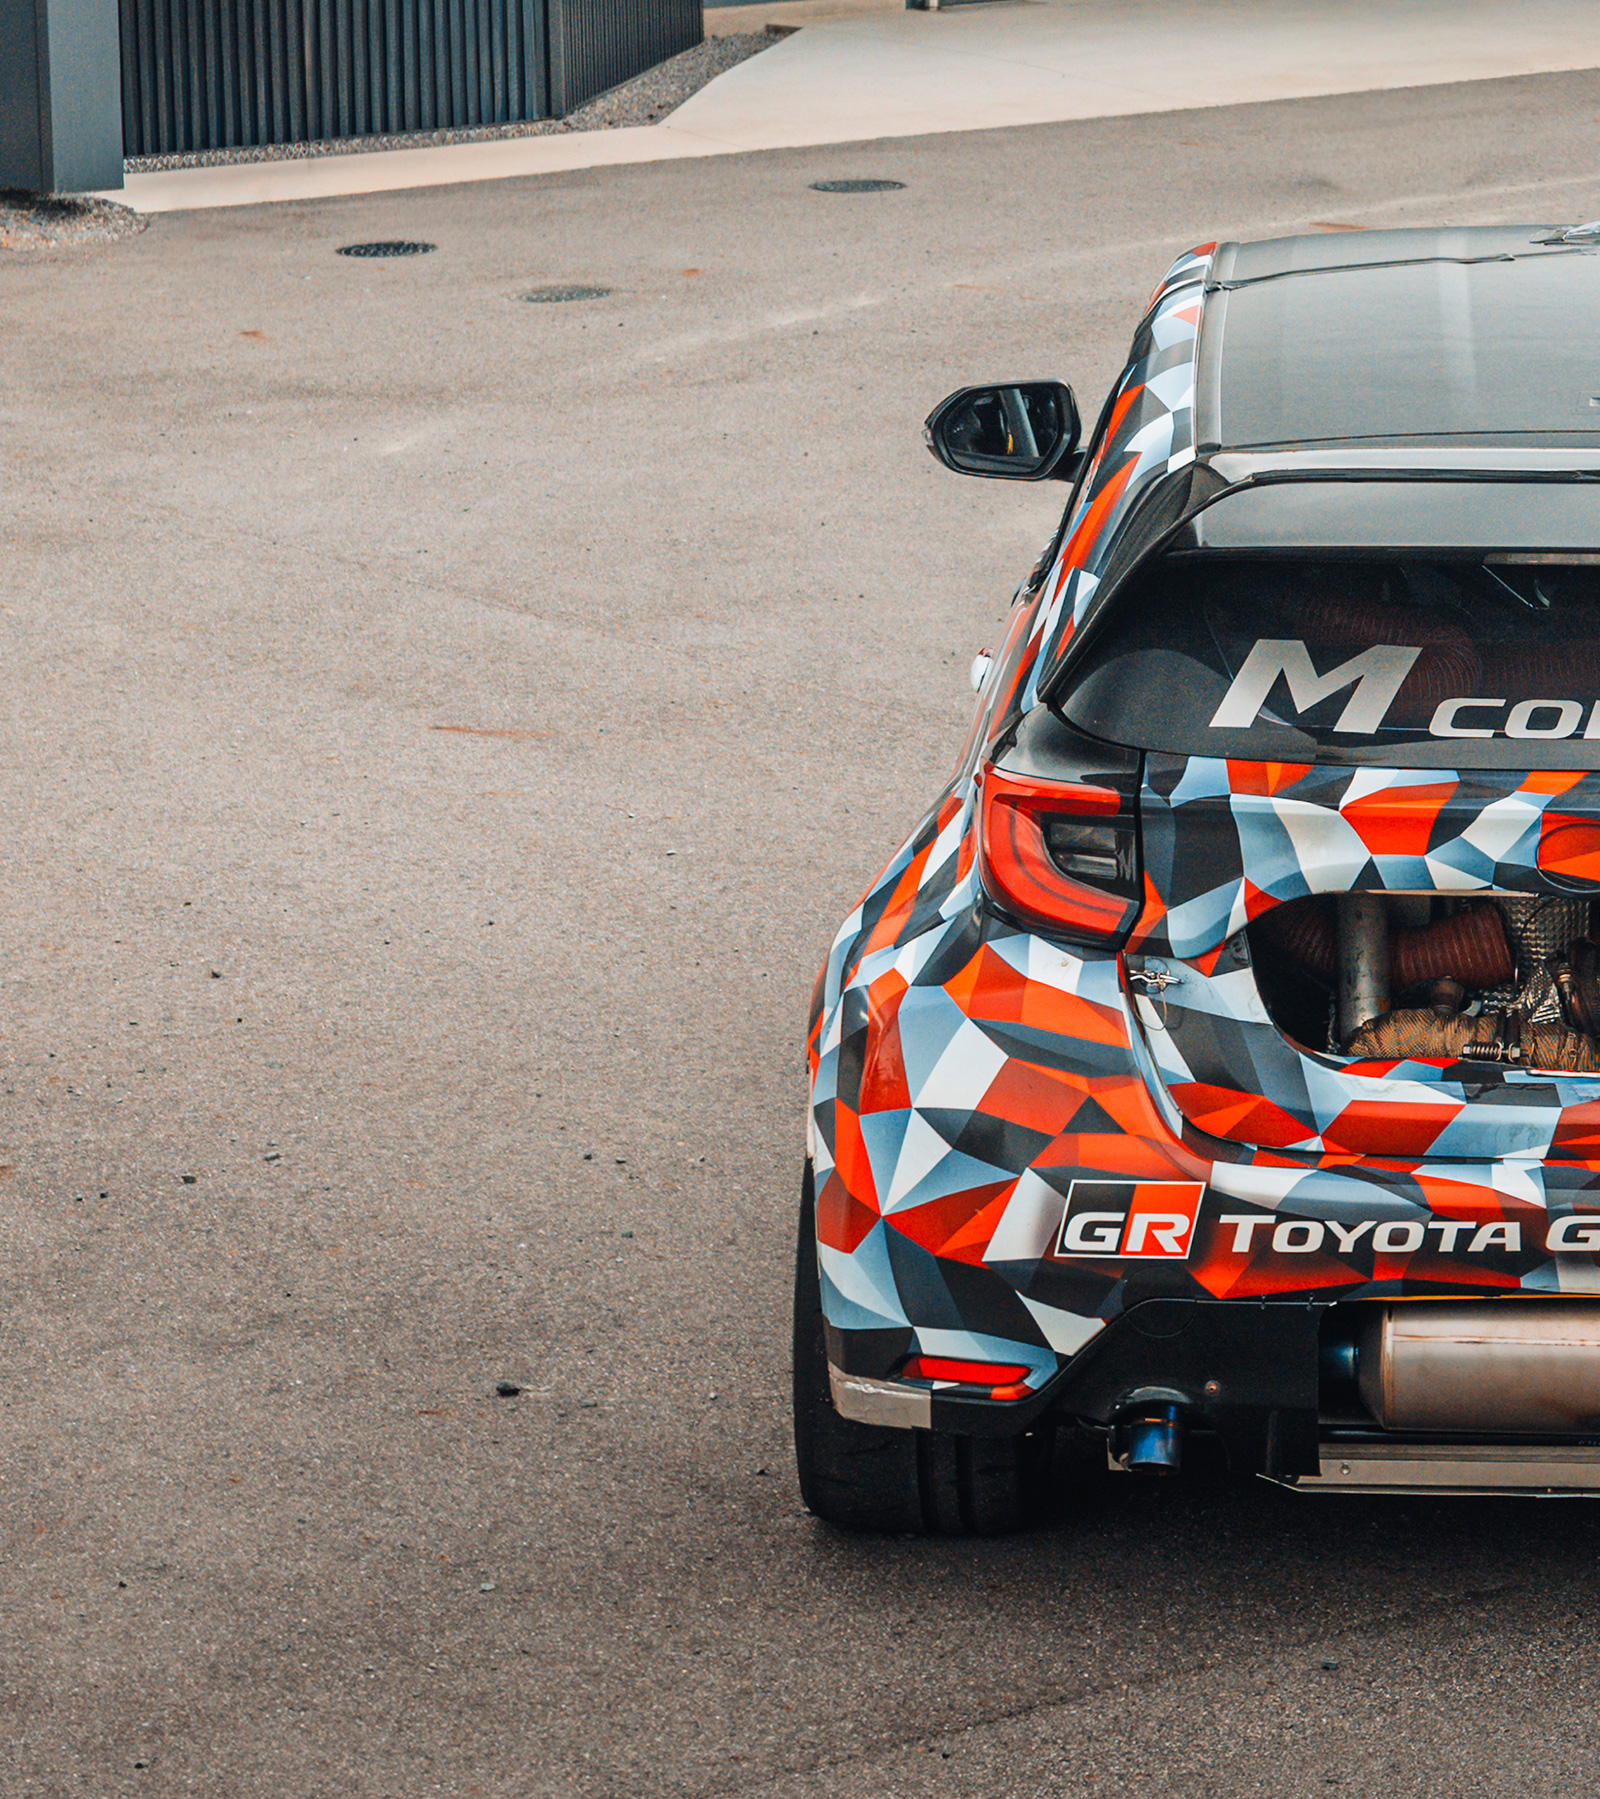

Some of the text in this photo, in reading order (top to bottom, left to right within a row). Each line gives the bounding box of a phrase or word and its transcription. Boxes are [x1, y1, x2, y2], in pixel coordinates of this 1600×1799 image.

[1209, 639, 1423, 735] M
[1064, 1212, 1190, 1253] GR
[1219, 1214, 1522, 1253] TOYOTA
